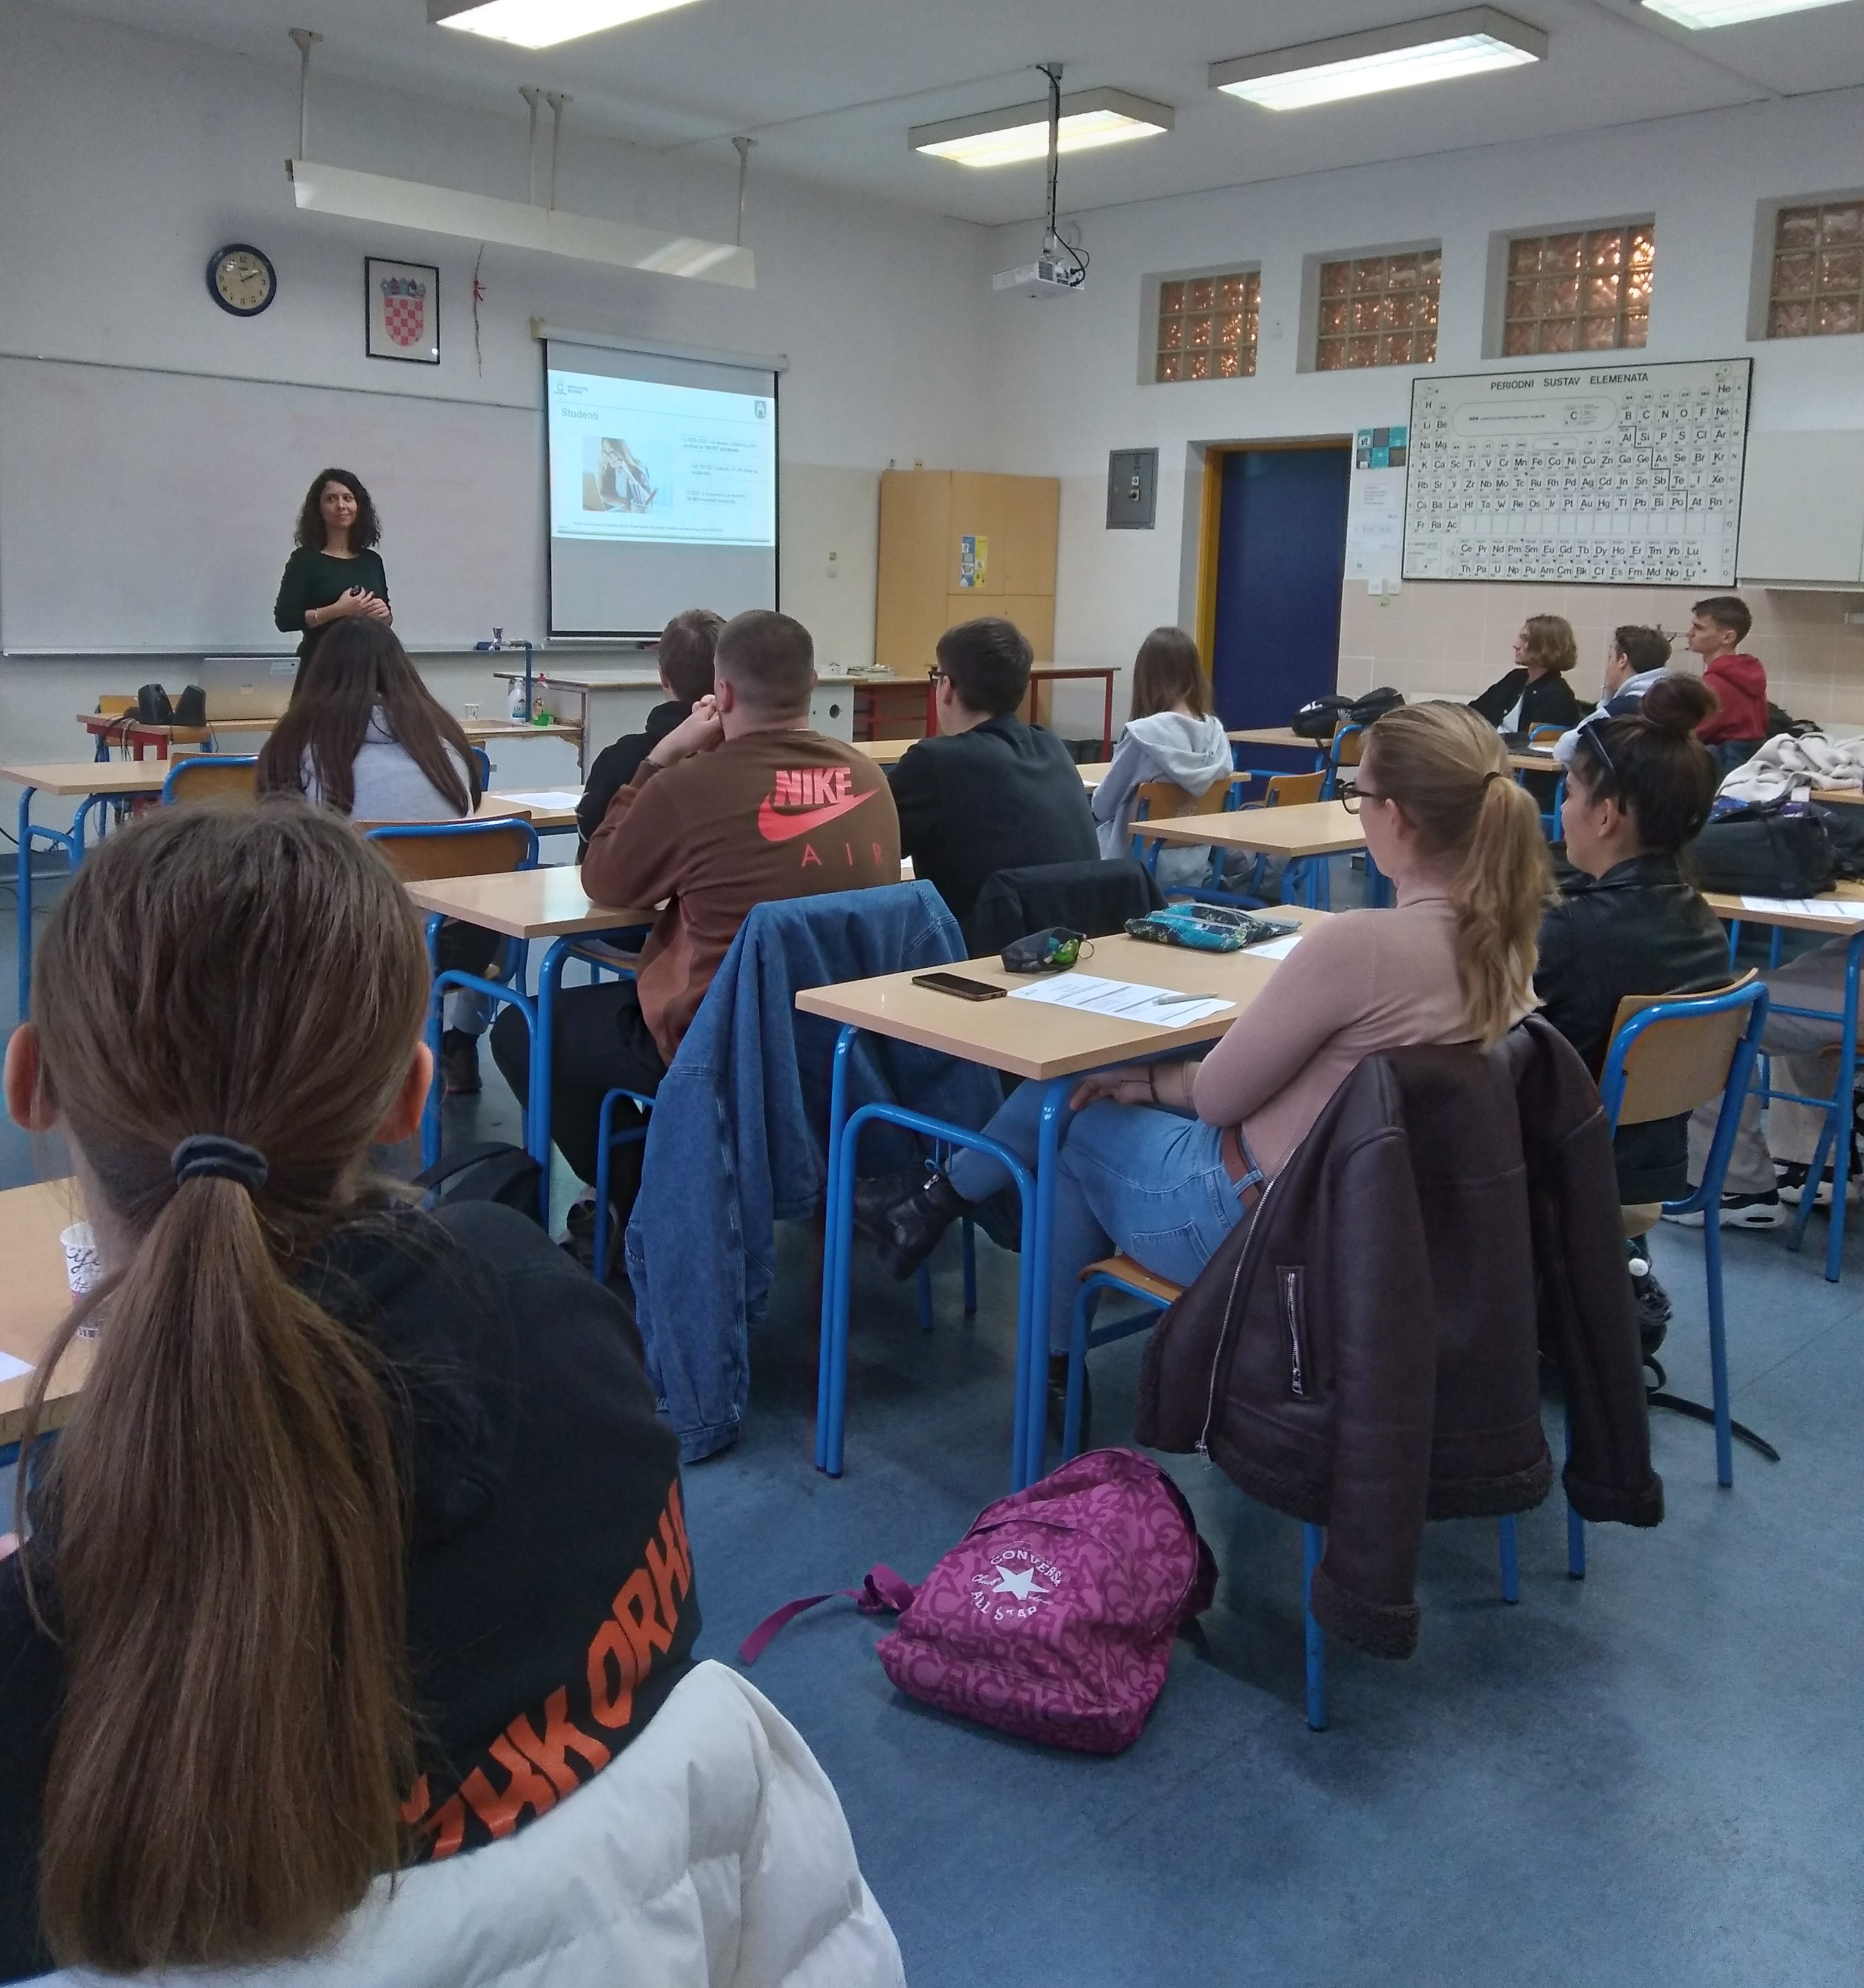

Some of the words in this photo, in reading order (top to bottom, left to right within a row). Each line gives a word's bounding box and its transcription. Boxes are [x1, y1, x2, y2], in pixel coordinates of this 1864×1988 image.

[1491, 380, 1534, 389] PERIODNI
[1544, 377, 1580, 386] SUSTAV
[1590, 373, 1648, 384] ELEMENATA
[1718, 385, 1731, 393] He
[562, 408, 598, 419] Studenti
[1571, 411, 1577, 420] C
[1625, 412, 1632, 420] B
[1643, 410, 1650, 419] C
[1681, 409, 1688, 418] O
[1435, 441, 1446, 451] Mg
[1641, 432, 1649, 441] Si
[1679, 431, 1685, 440] S
[1697, 430, 1707, 439] Cl
[1434, 461, 1445, 469] Ca
[1450, 460, 1461, 469] Sc
[1549, 457, 1561, 465] Co
[1602, 456, 1613, 464] Zn
[1619, 455, 1631, 463] Ga
[1637, 455, 1650, 463] Ge
[1674, 453, 1686, 462] Se
[1695, 453, 1704, 462] Br
[1714, 452, 1724, 461] Kr
[1480, 480, 1492, 489] Nb
[1531, 479, 1541, 487] Ru
[1582, 478, 1594, 488] Ag
[1599, 477, 1612, 486] Cd
[1635, 476, 1647, 486] Sn
[1654, 476, 1666, 484] Sb
[1674, 476, 1684, 484] Te
[1416, 501, 1427, 510] Cs
[1513, 500, 1523, 508] Re
[1580, 499, 1592, 508] Au
[1598, 499, 1610, 509] Hg
[1672, 498, 1684, 506] Po
[1710, 498, 1722, 506] Rn
[1431, 521, 1441, 529] Ra
[1446, 521, 1457, 529] Ac
[1461, 544, 1472, 553] Ce
[1525, 545, 1538, 554] Sm
[1577, 546, 1589, 555] Tb
[1595, 546, 1607, 557] Dy
[1632, 547, 1641, 555] Er
[1649, 546, 1661, 555] Tm
[1668, 547, 1679, 556] Yb
[1687, 547, 1699, 556] Lu
[1507, 566, 1519, 576] Np
[1540, 566, 1554, 575] Am
[1557, 566, 1572, 575] Cm
[1575, 567, 1586, 576] Bk
[1593, 567, 1605, 576] Cf
[1665, 568, 1679, 577] No
[1686, 569, 1696, 578] Lr
[774, 767, 854, 806] NIKE
[801, 843, 882, 867] AIR
[971, 1591, 991, 1614] ALL
